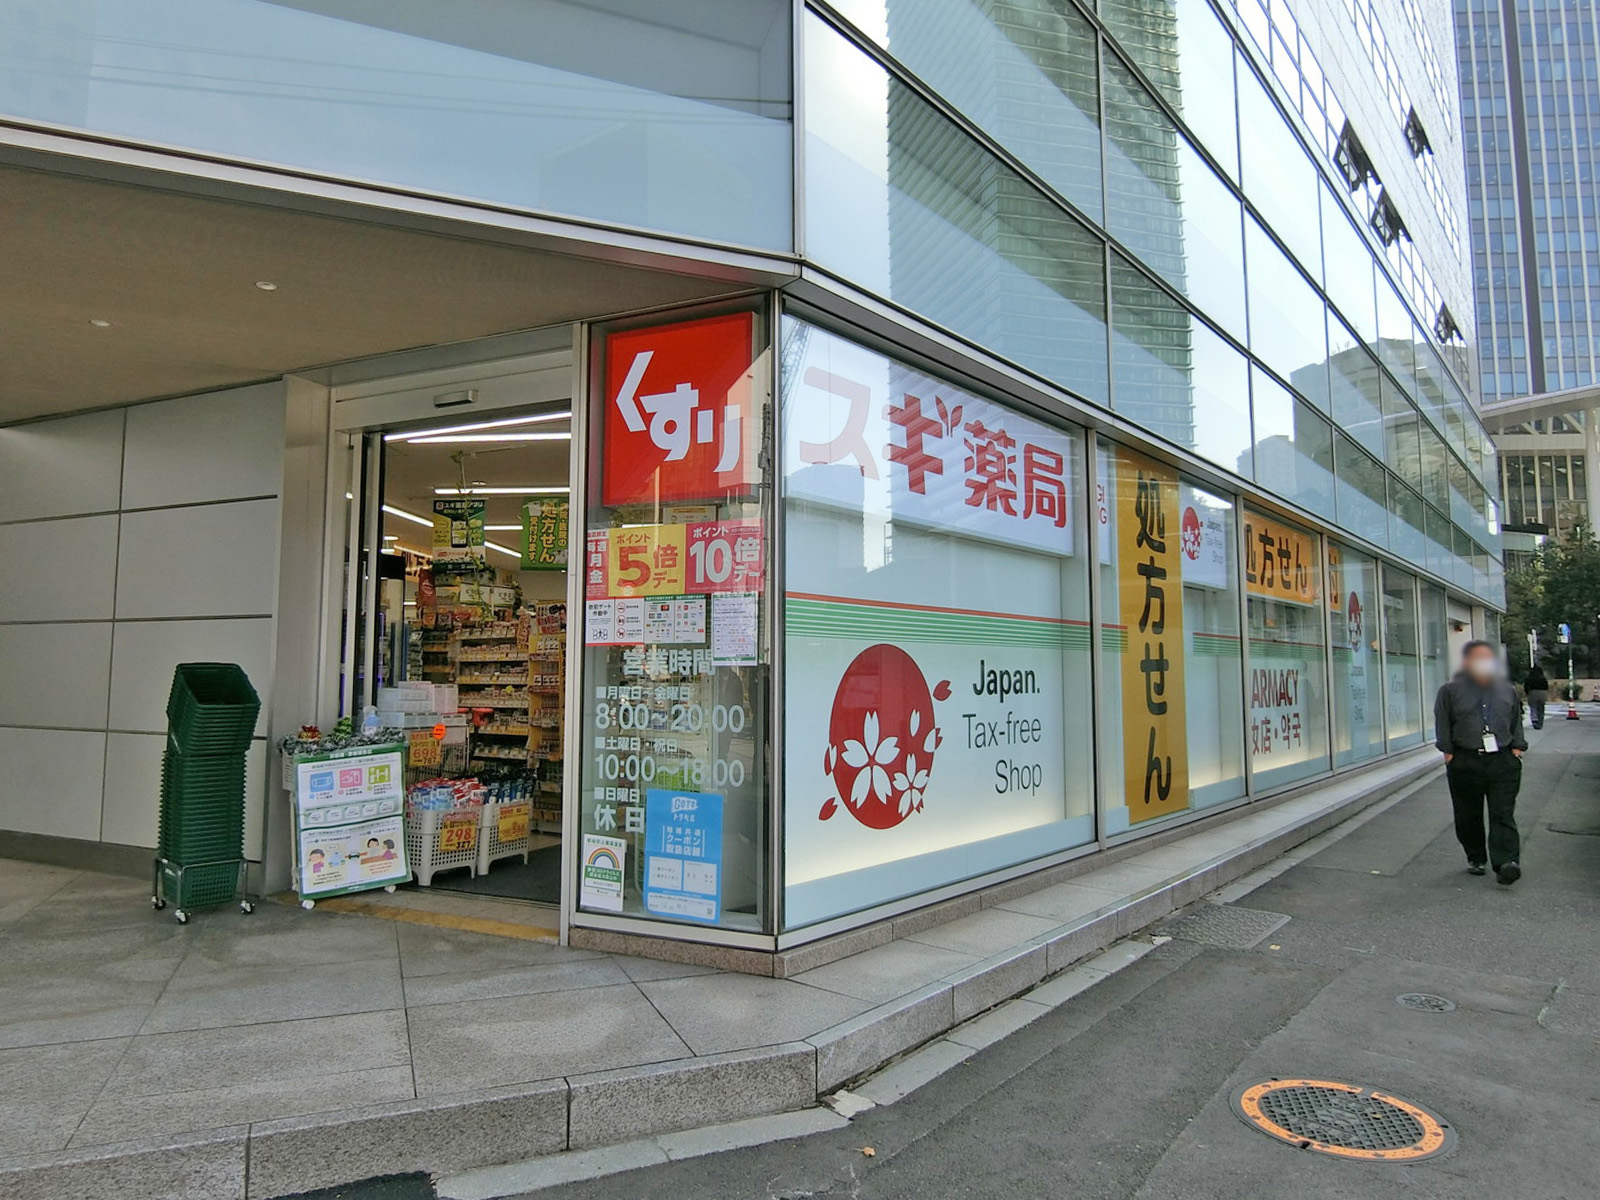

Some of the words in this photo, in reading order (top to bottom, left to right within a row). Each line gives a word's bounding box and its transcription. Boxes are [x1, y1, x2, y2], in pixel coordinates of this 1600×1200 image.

[616, 351, 741, 473] くすり
[800, 366, 1067, 528] スギ薬局
[616, 533, 651, 544] ポイント
[693, 526, 729, 538] ポイント
[590, 553, 602, 567] 月
[1135, 477, 1171, 804] 処方せん
[623, 648, 716, 676] 営業時間
[972, 659, 1041, 703] Japan.
[1251, 669, 1299, 708] ARMACY
[962, 711, 1042, 749] Tax-free
[994, 759, 1042, 796] Shop
[606, 787, 640, 803] 日曜日
[446, 827, 471, 843] 298
[667, 834, 701, 846] クーポン
